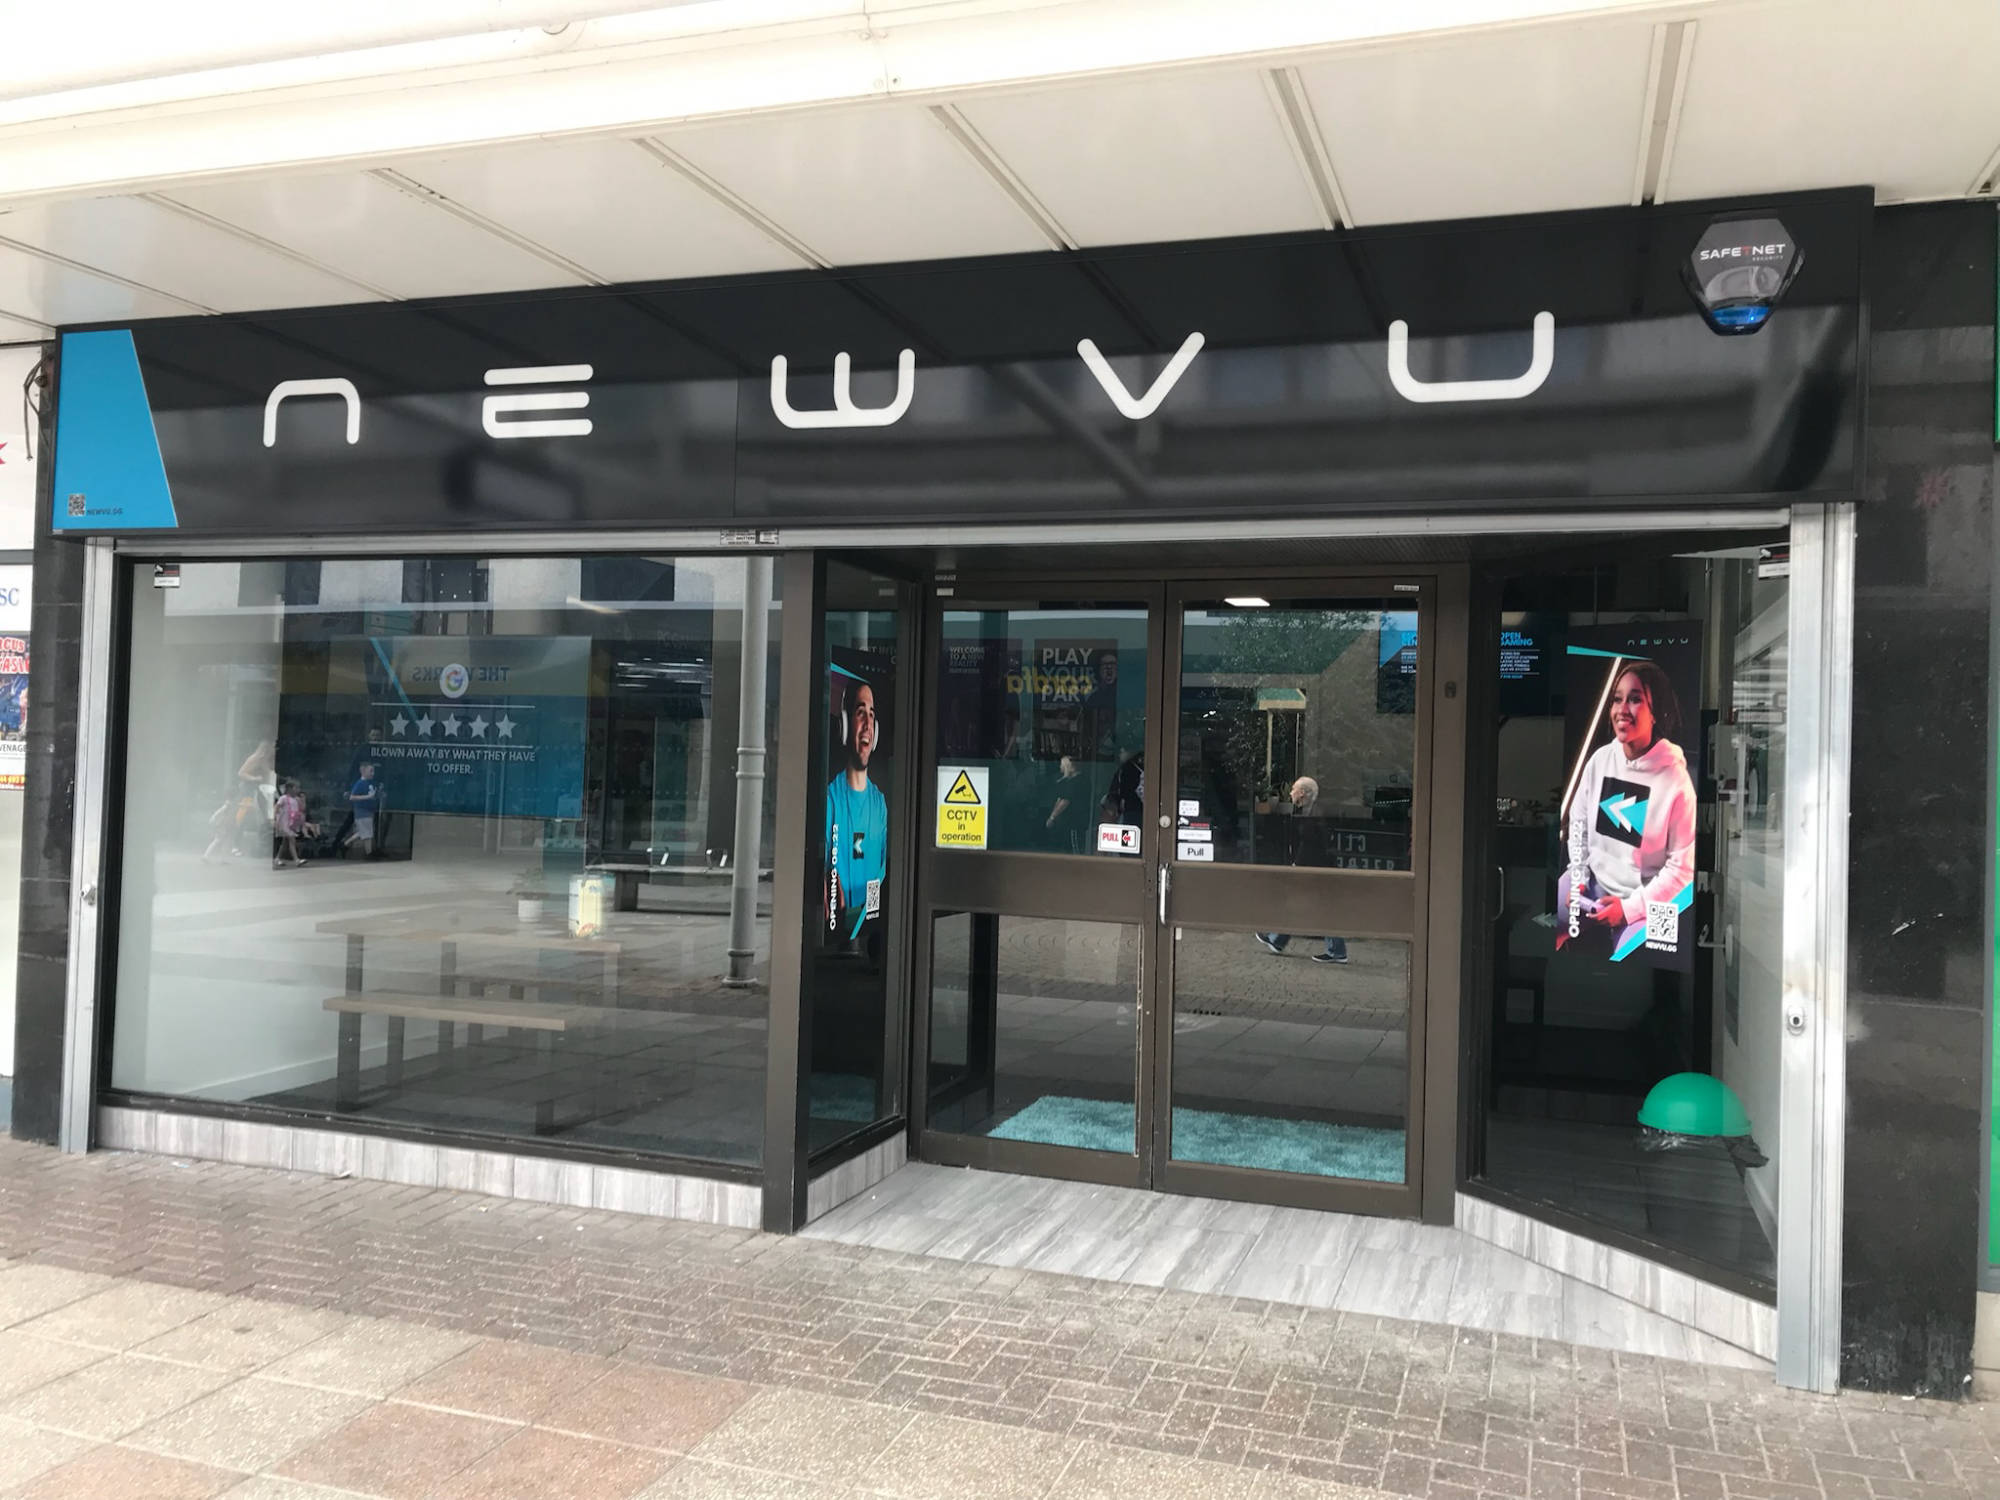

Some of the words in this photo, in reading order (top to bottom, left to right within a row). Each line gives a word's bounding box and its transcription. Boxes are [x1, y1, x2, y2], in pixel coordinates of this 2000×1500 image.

[1042, 648, 1093, 665] PLAY
[370, 747, 405, 758] BLOWN
[407, 748, 437, 759] AWAY
[438, 749, 450, 759] BY
[452, 749, 480, 760] WHAT
[483, 750, 506, 761] THEY
[509, 751, 536, 762] HAVE
[427, 763, 440, 772] TO
[441, 763, 474, 774] OFFER.
[947, 809, 978, 821] CCTV
[958, 822, 966, 831] in
[941, 832, 982, 842] operation
[1102, 832, 1119, 842] PULL
[1187, 847, 1204, 857] Pull
[829, 867, 839, 931] OPENING
[1568, 868, 1581, 938] OPENING
